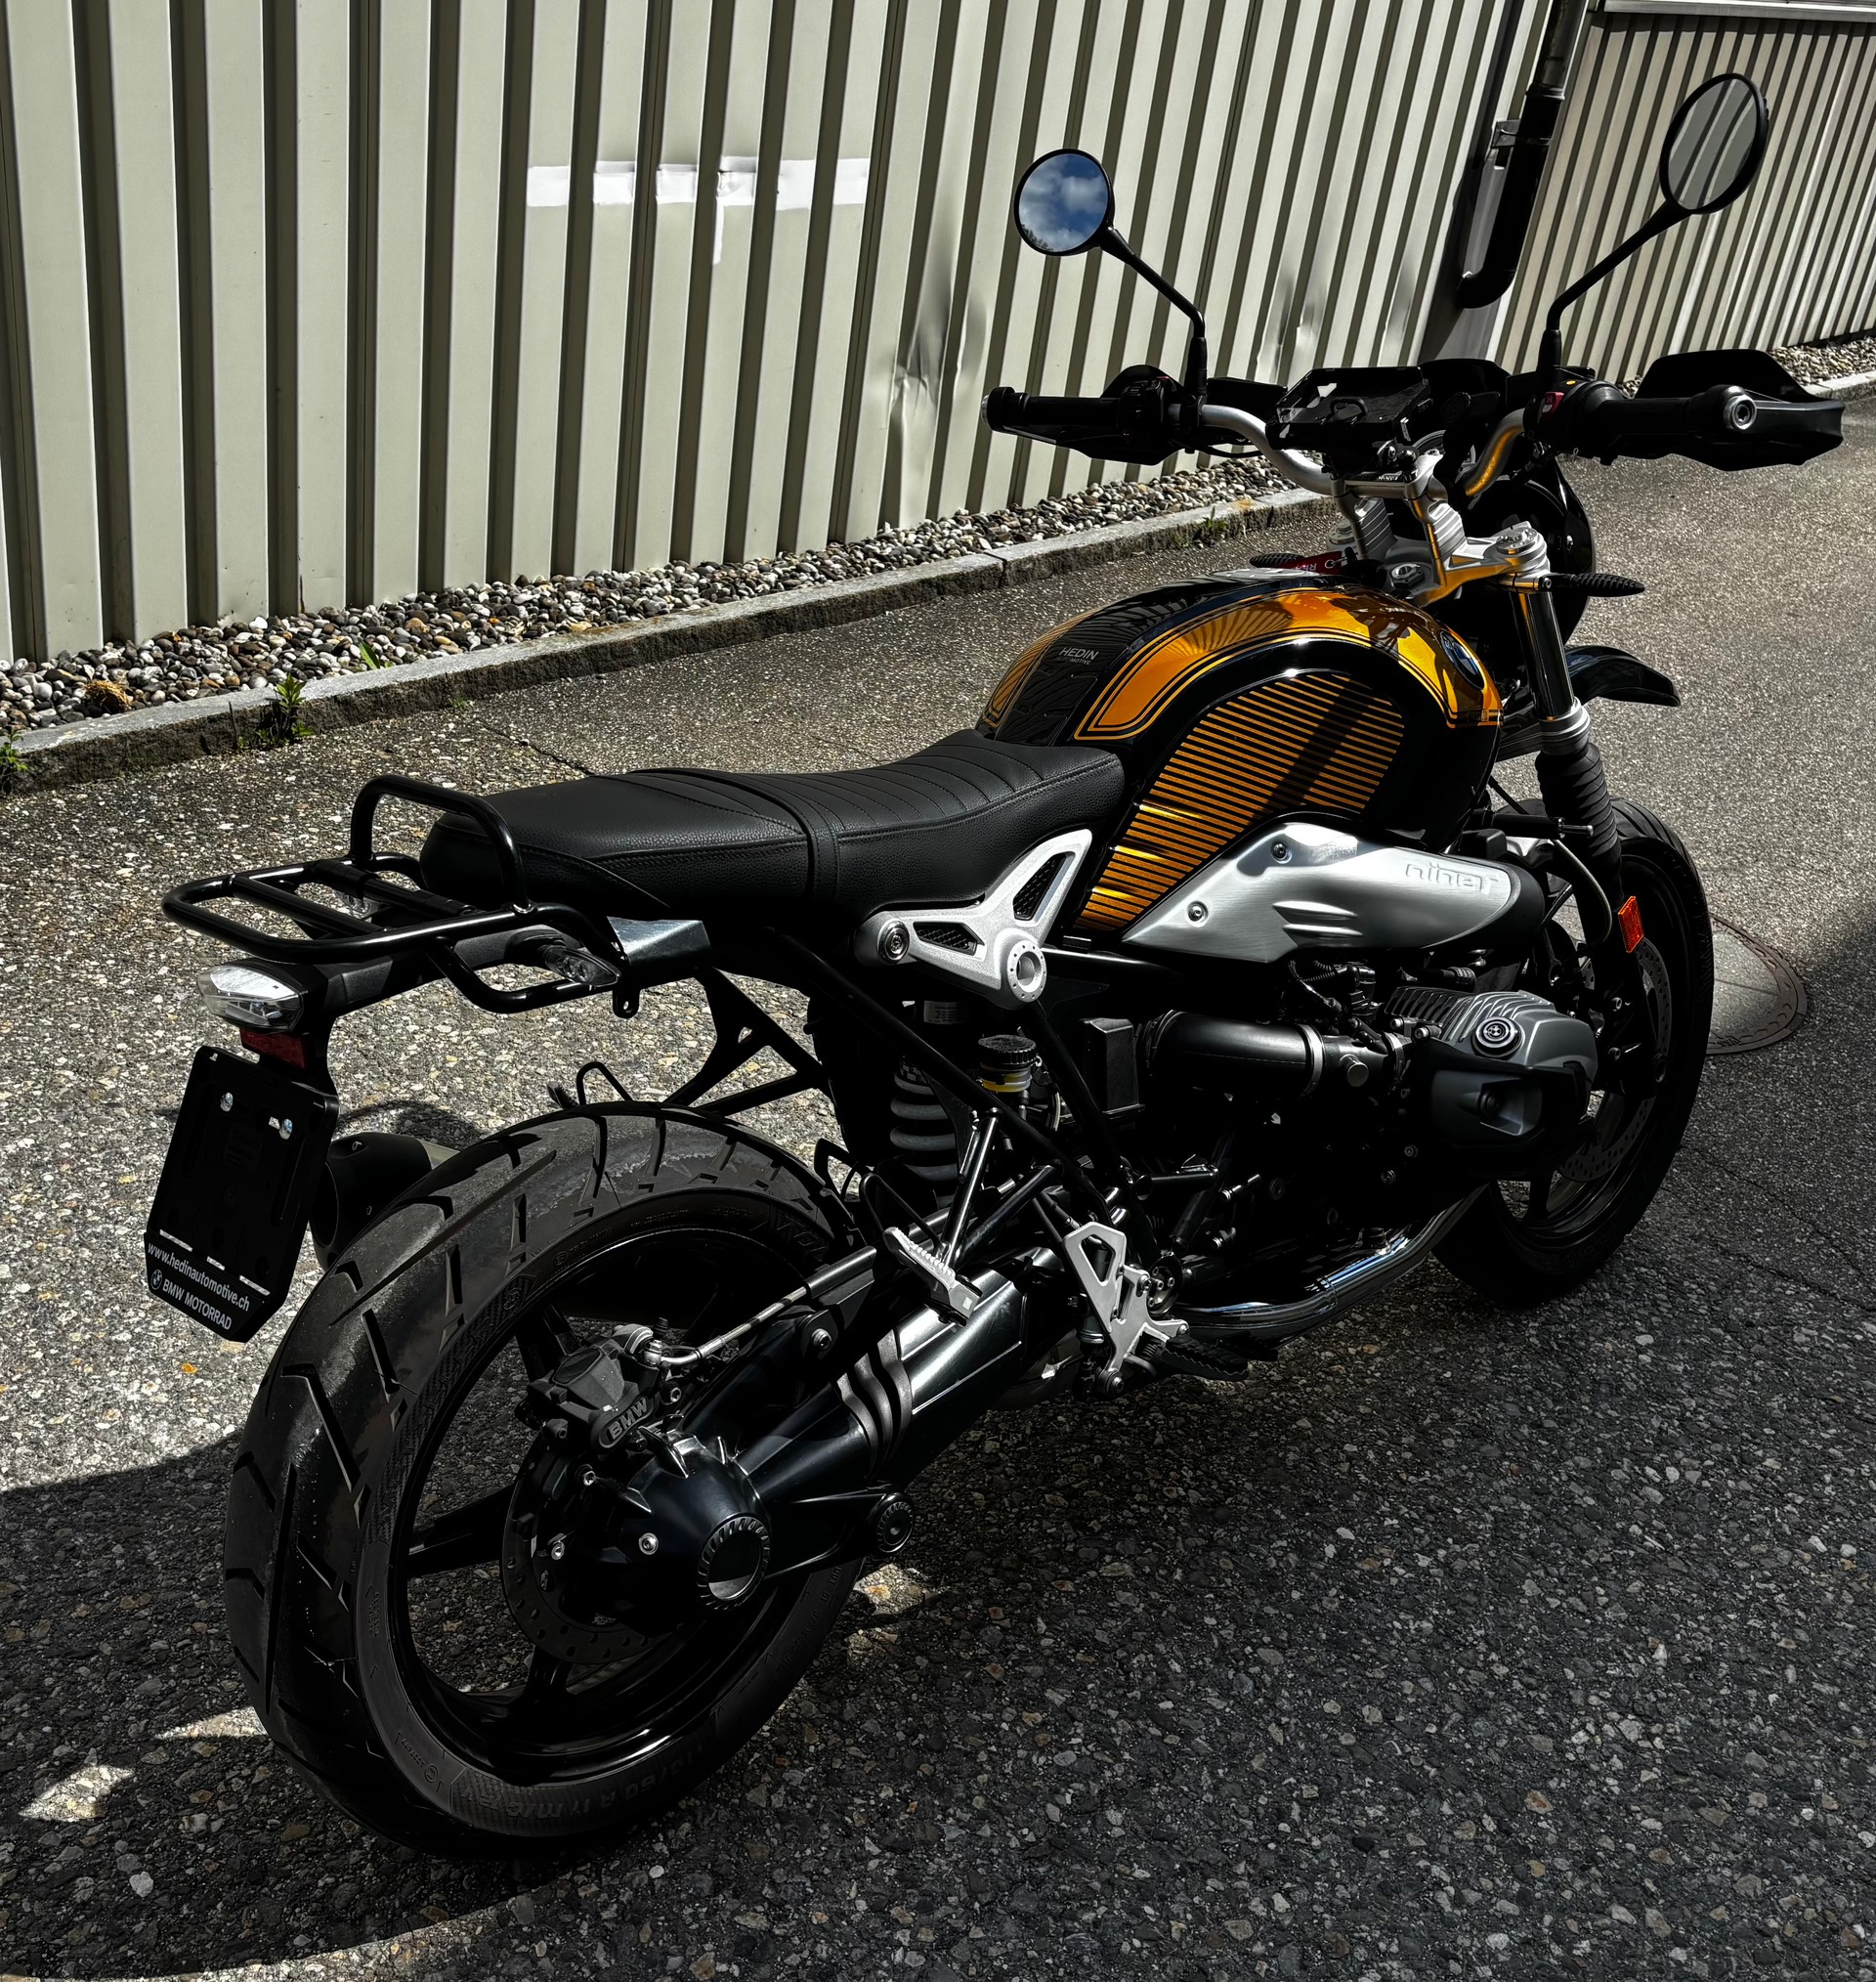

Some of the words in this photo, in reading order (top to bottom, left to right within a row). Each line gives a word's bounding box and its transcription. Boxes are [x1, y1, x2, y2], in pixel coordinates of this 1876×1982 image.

[1058, 647, 1099, 661] HEDIN
[148, 1243, 250, 1313] www.hedinautomotive.ch
[162, 1278, 185, 1302] BMW
[184, 1291, 233, 1331] MOTORRAD
[608, 1397, 649, 1441] BMW
